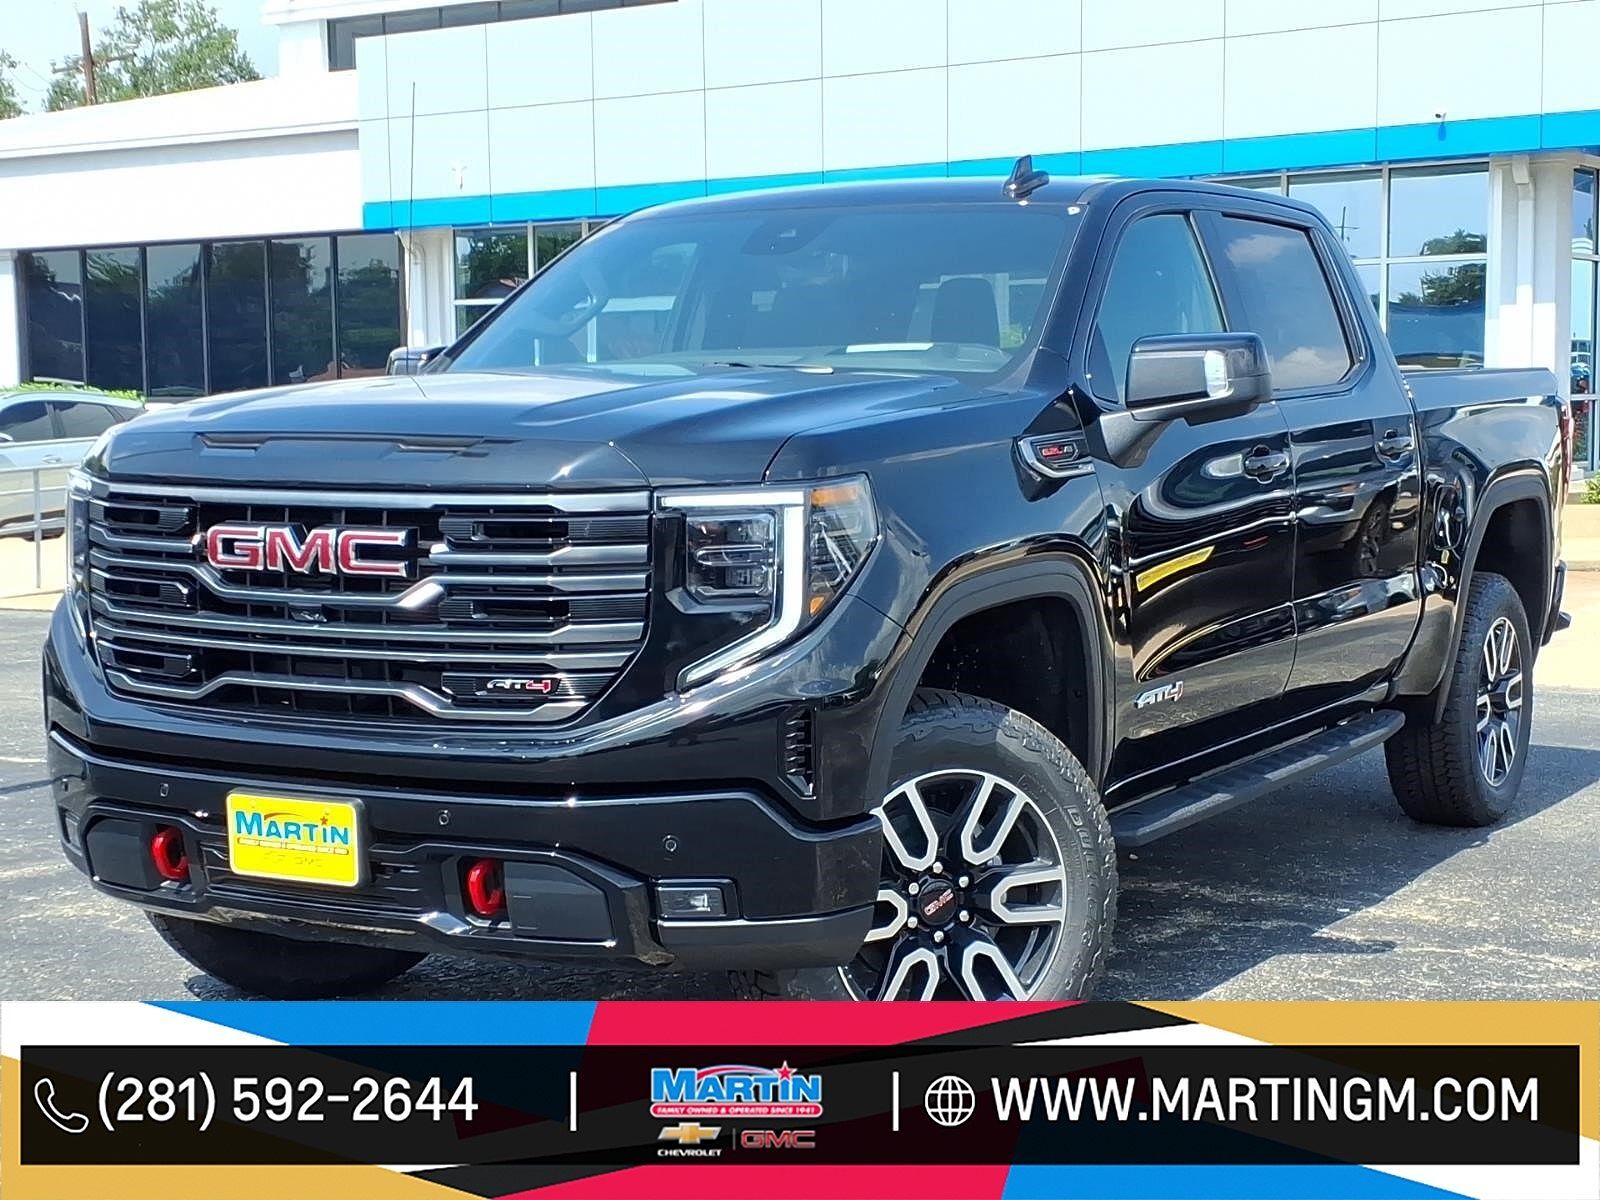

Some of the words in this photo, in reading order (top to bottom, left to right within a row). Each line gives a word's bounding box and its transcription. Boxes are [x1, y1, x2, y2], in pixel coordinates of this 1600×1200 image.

[206, 525, 408, 577] GMC
[486, 679, 551, 693] AT4
[1135, 680, 1184, 709] AT4
